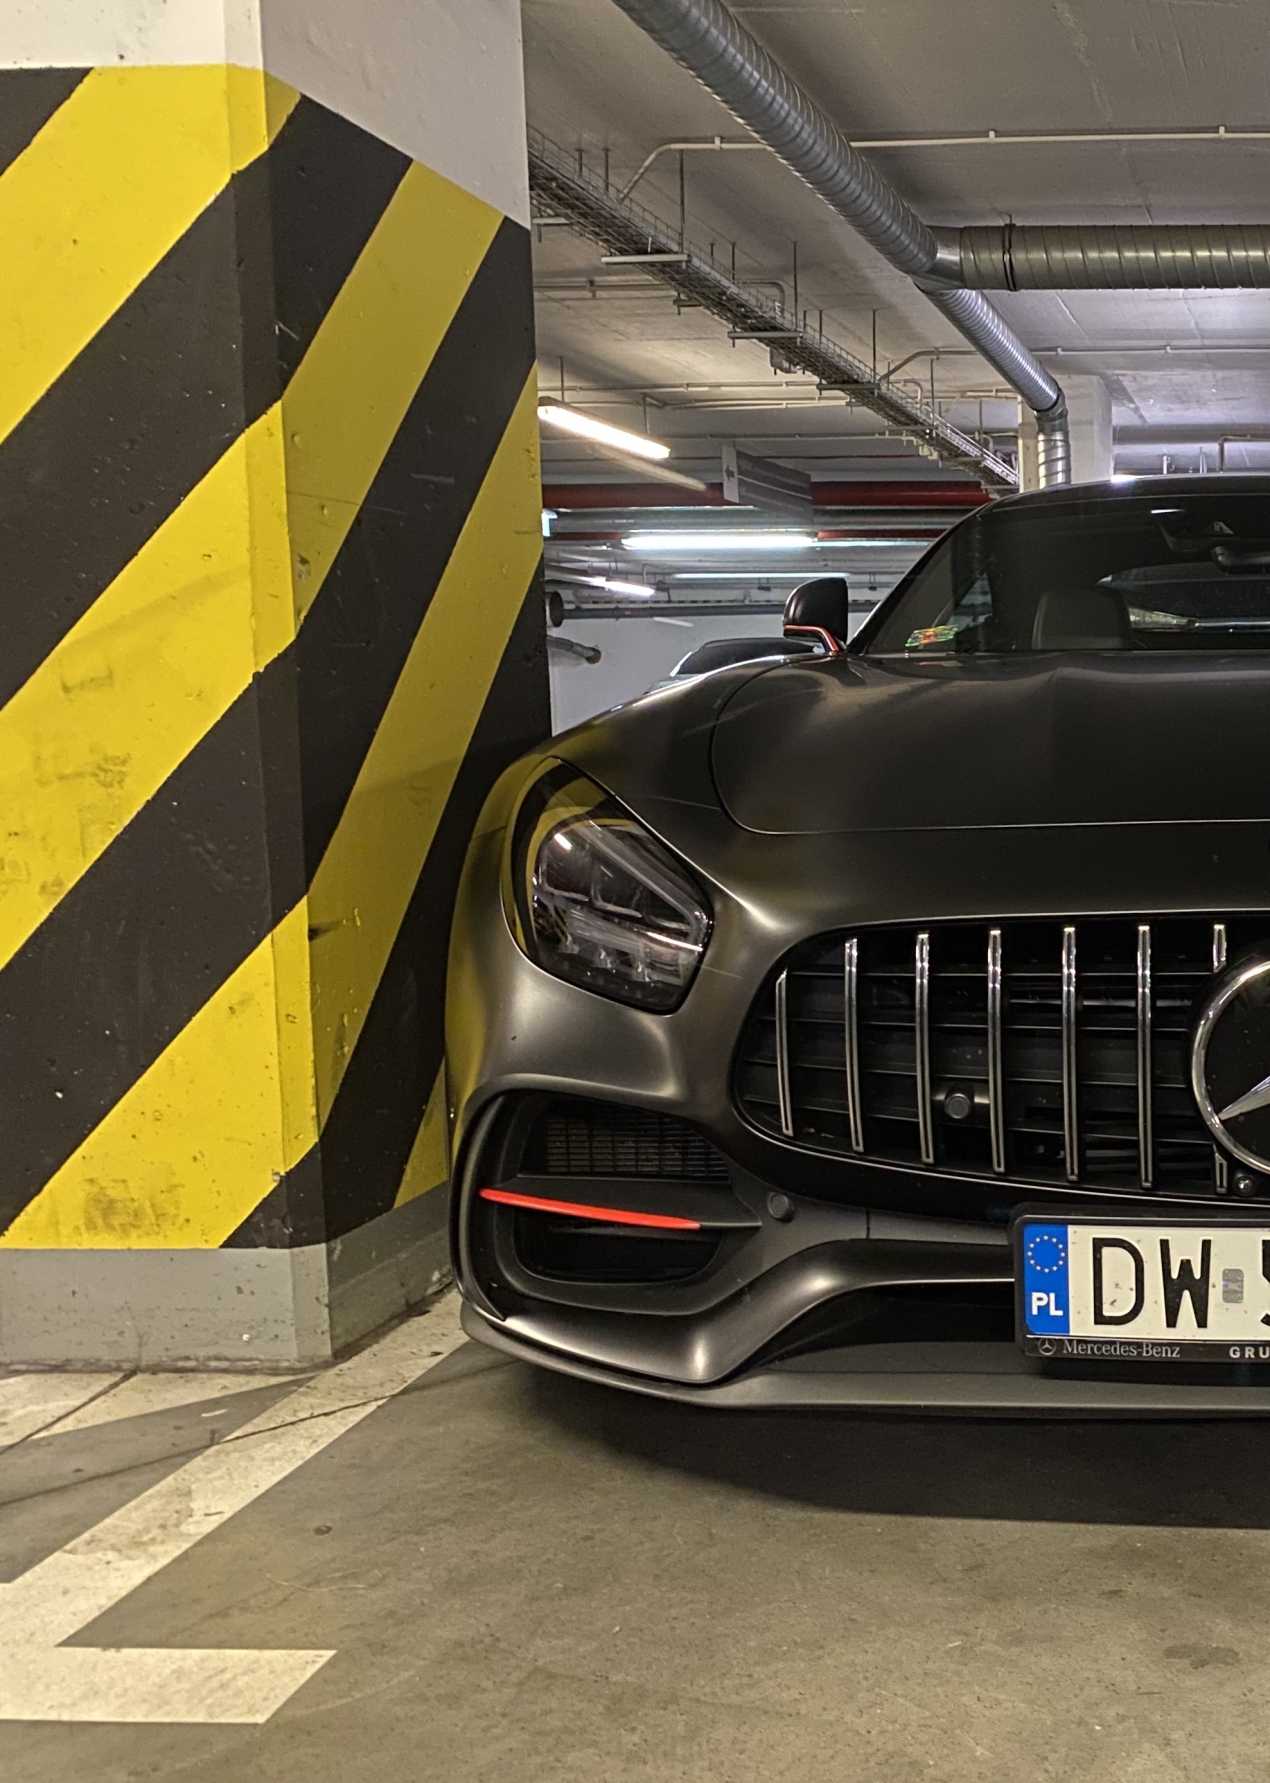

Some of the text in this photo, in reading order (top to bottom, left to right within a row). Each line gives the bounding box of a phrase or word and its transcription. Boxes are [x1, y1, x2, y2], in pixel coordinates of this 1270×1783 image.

[1092, 1237, 1213, 1329] DW
[1031, 1292, 1064, 1316] PL
[1063, 1339, 1181, 1359] Mercedes-Benz
